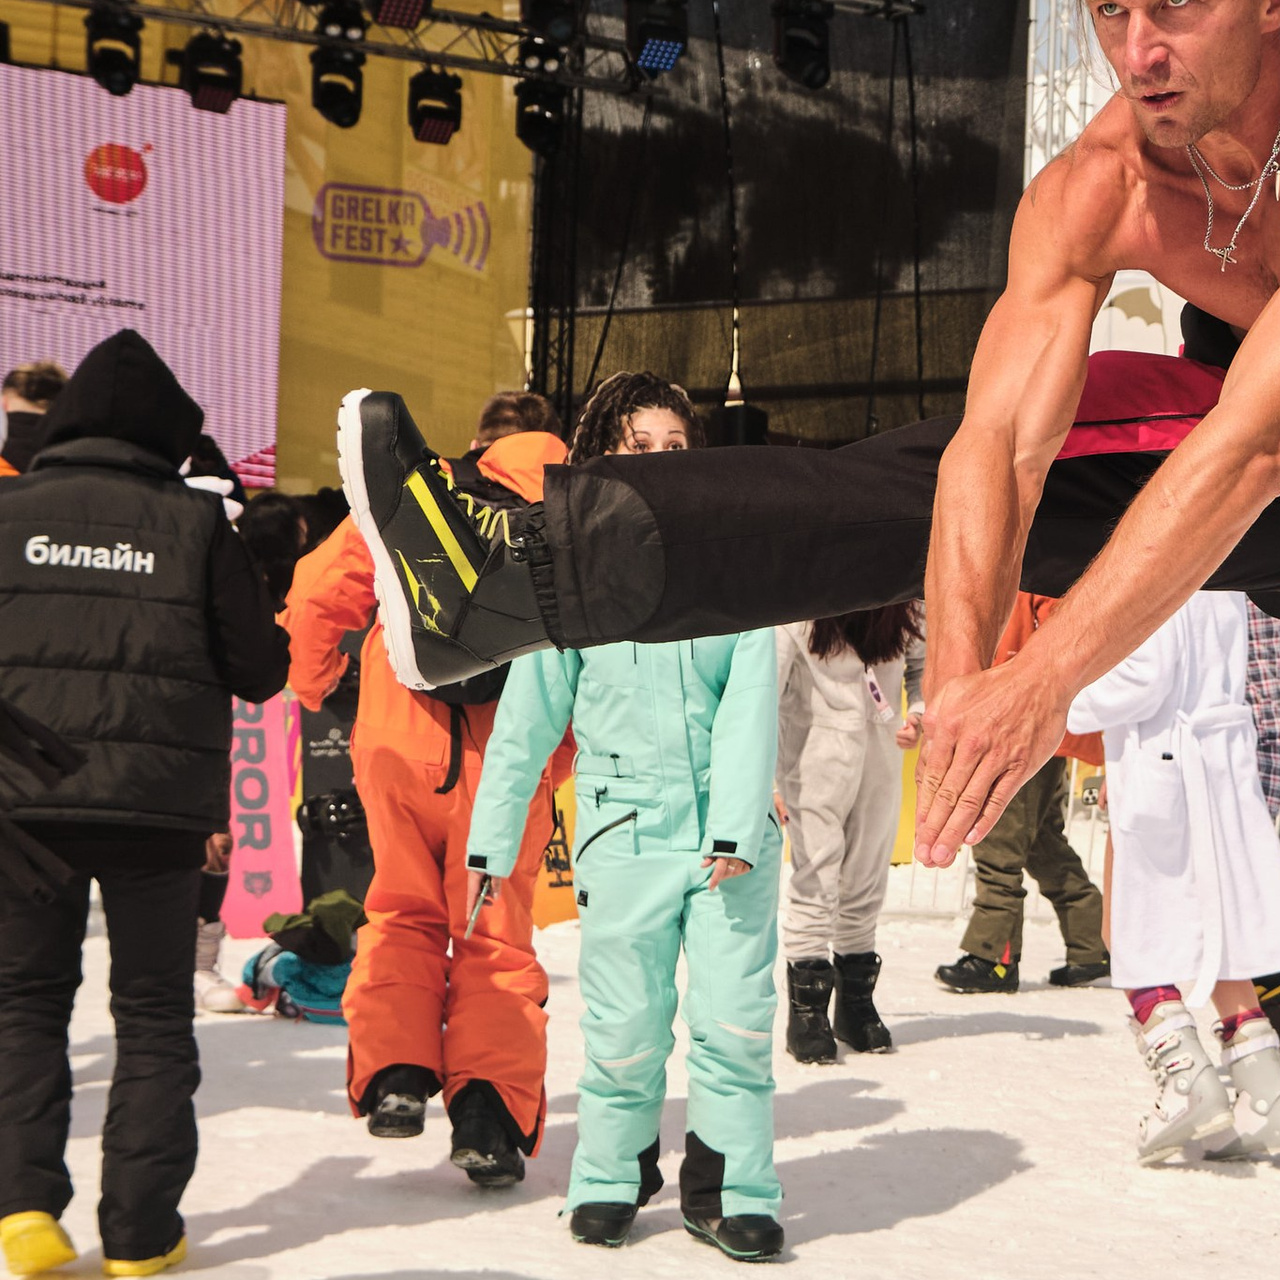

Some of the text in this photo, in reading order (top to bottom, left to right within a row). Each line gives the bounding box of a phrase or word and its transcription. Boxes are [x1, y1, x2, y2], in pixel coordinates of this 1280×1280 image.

[331, 194, 415, 226] GRELKA
[330, 223, 387, 253] FEST
[25, 535, 155, 574] билайн
